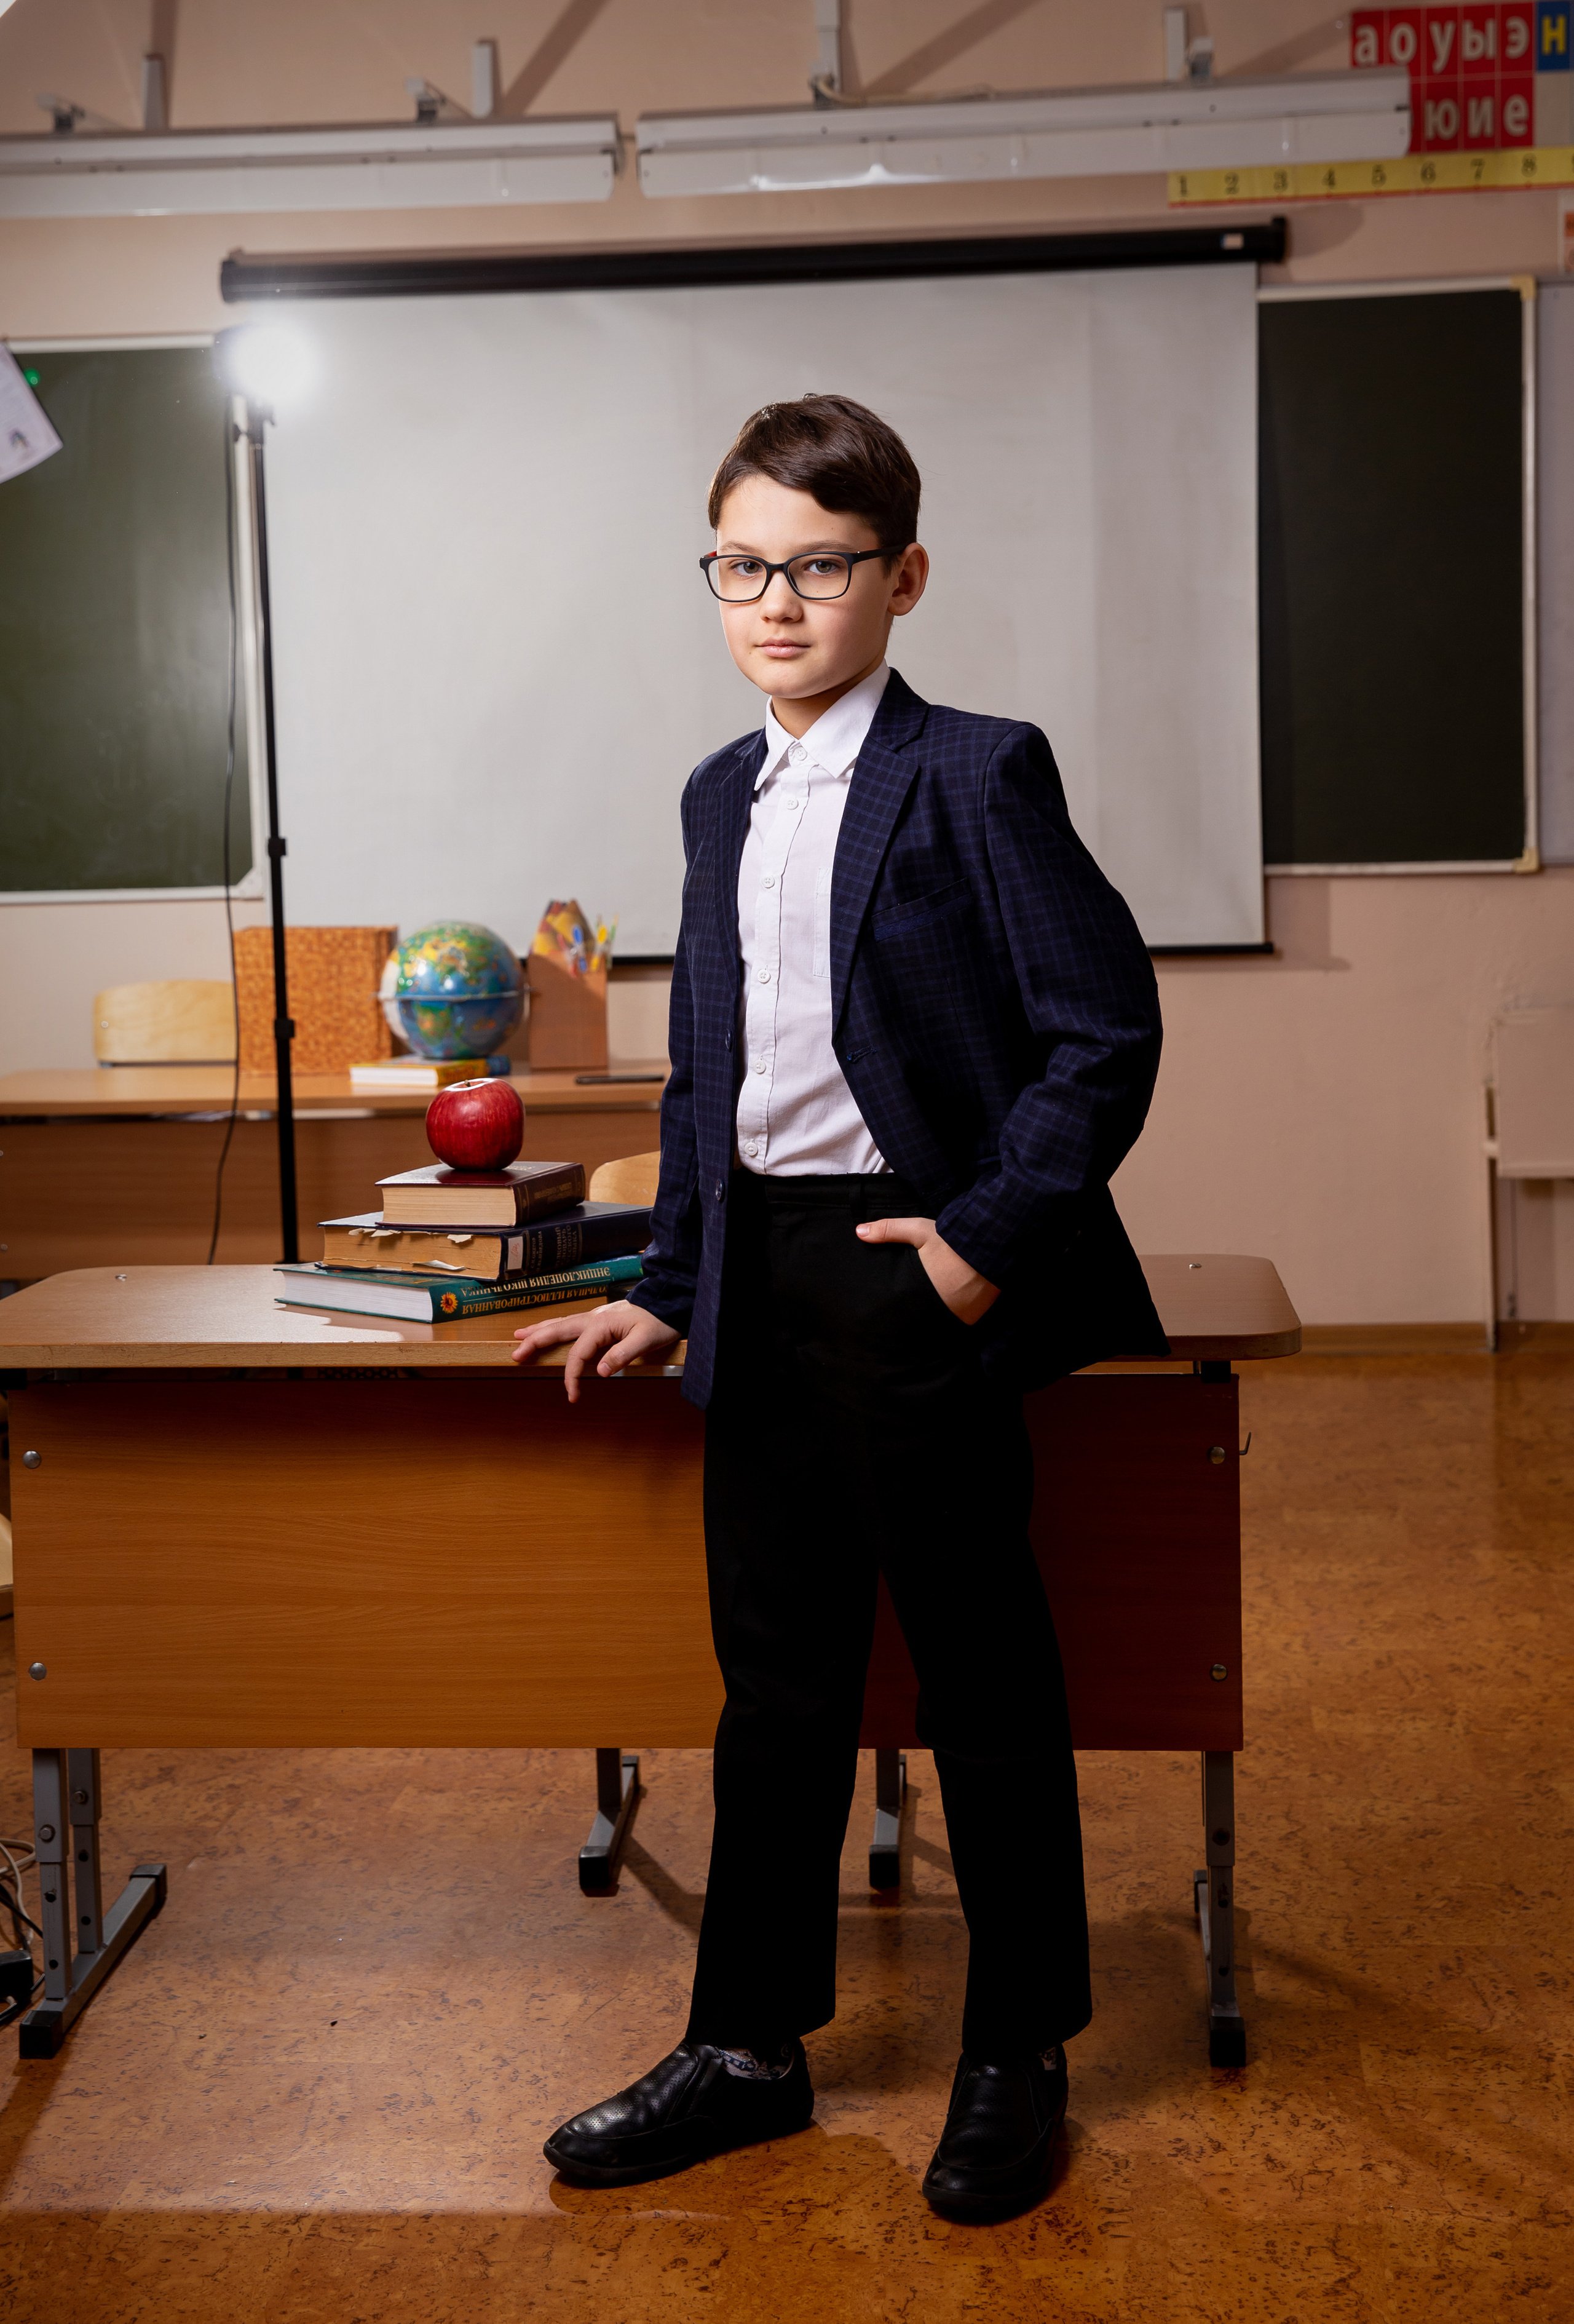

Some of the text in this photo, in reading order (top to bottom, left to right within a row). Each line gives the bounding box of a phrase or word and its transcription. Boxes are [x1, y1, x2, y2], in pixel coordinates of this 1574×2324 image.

[1179, 154, 1537, 197] 1 2 3 4 5 6 7 8
[529, 1267, 611, 1287] ЭНЦИКЛОПЕДИЯ
[462, 1285, 606, 1314] ОЛЬШАЯ ИЛЛЮСТРИРОВАННАЯ
